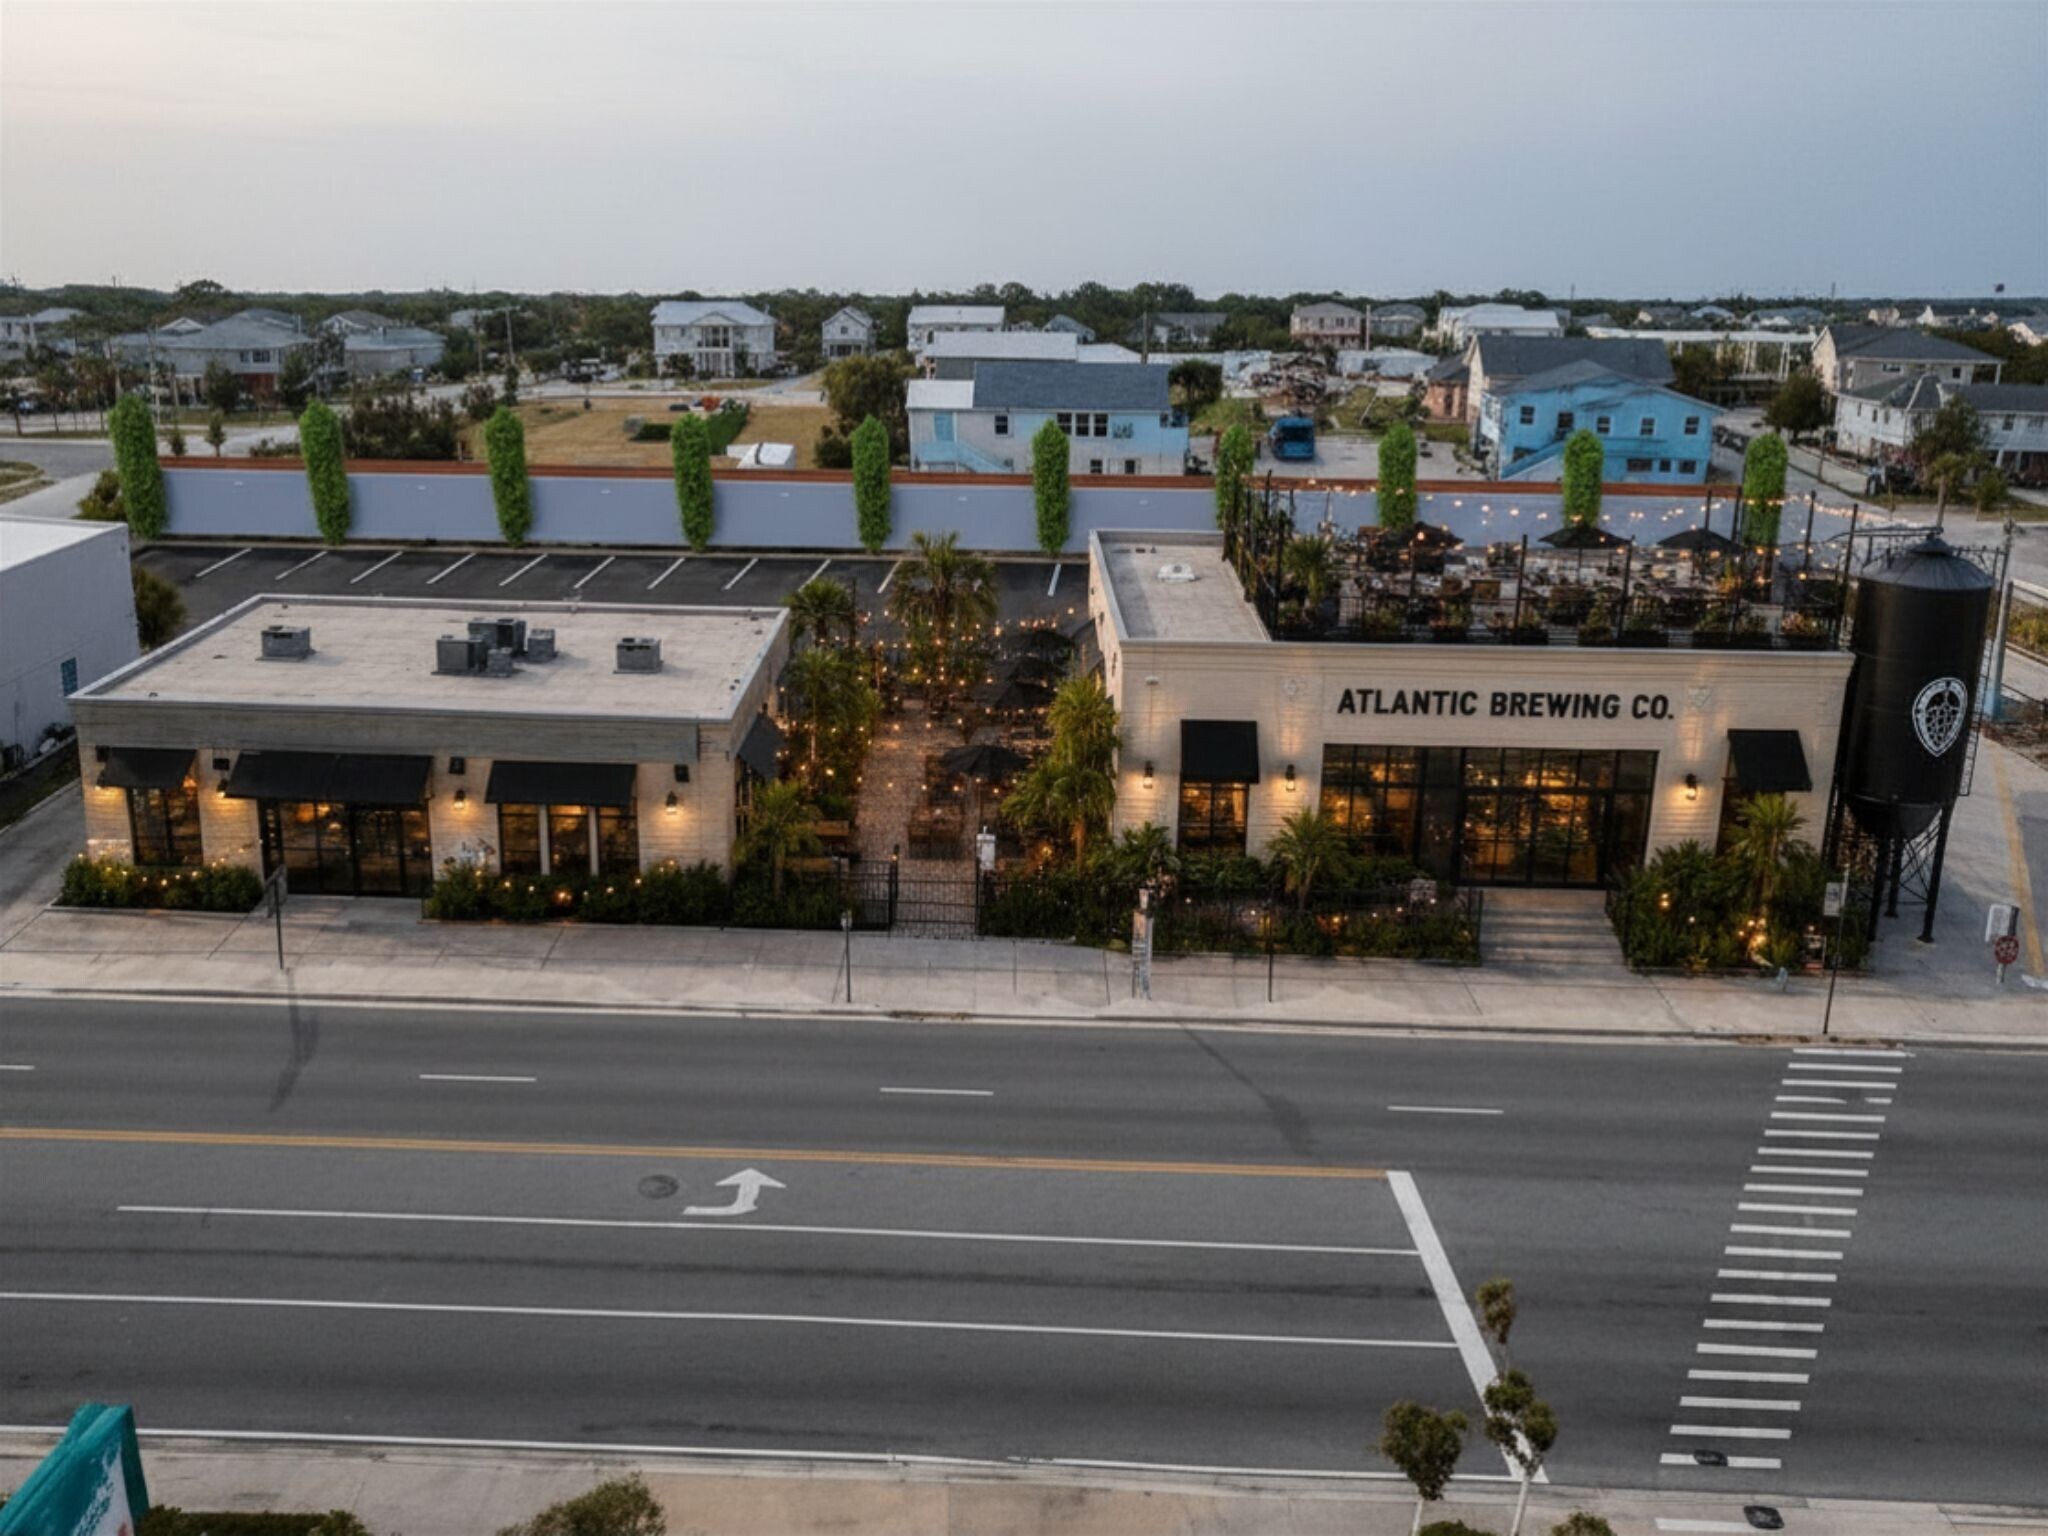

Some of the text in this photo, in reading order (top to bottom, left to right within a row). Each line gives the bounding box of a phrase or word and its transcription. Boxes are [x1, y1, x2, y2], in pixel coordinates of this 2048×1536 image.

[1338, 688, 1674, 720] ATLANTIC BREWING CO.
